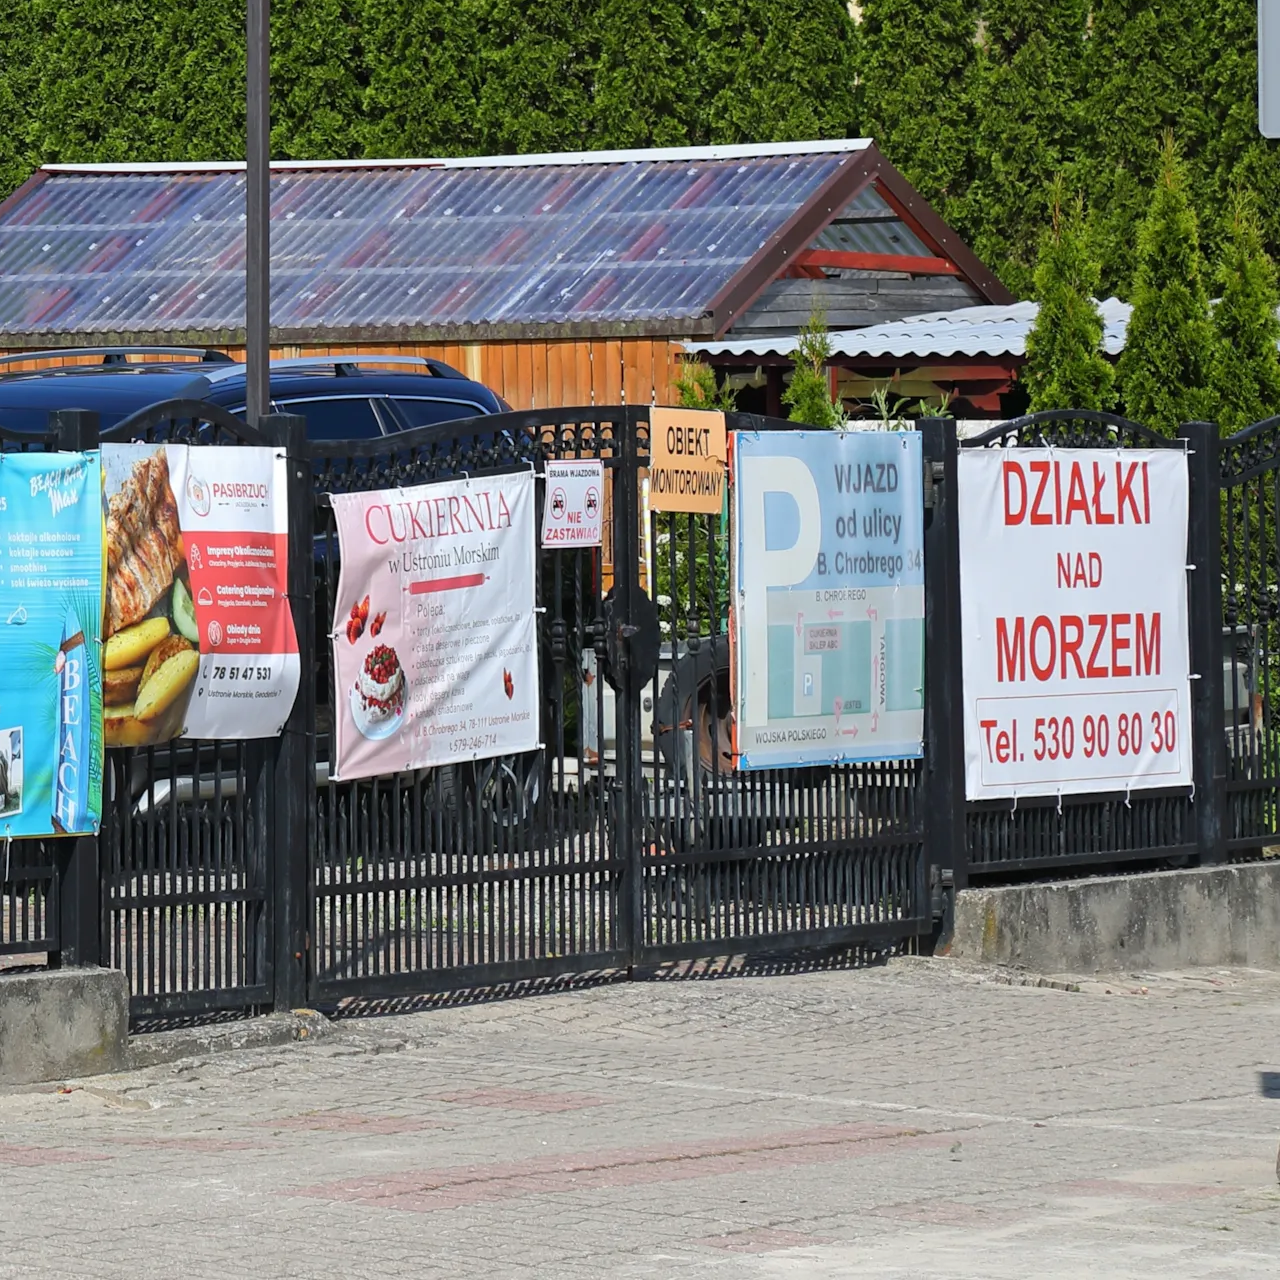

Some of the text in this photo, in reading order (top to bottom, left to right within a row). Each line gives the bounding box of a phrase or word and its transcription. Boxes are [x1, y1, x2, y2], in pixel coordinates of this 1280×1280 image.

[666, 426, 711, 457] OBIEKT
[30, 468, 61, 497] BEACH
[549, 469, 569, 478] BRAMA
[650, 469, 722, 497] MONITOROWANY
[834, 463, 899, 494] WJAZD
[48, 487, 79, 519] Max
[1003, 460, 1151, 526] DZIAŁKI
[365, 490, 512, 545] CUKIERNIA
[567, 512, 582, 524] NIE
[835, 508, 902, 545] od ulicy
[8, 531, 81, 545] koktajle alkoholowe
[545, 524, 598, 541] ZASTAWIAĆ
[9, 547, 74, 560] koktajle owocowe
[388, 542, 500, 574] w Ustroniu Morskim
[817, 549, 922, 579] B. Chrobrego 34
[1057, 552, 1103, 589] NAD
[742, 456, 821, 728] P
[816, 591, 823, 602] B.
[417, 604, 446, 619] Poleca:
[226, 623, 248, 637] Obiady
[464, 634, 490, 647] pieczone
[996, 612, 1161, 683] MORZEM
[445, 653, 473, 665] sztukowe
[213, 666, 271, 680] 78 51 47 531
[446, 672, 455, 680] na
[208, 690, 232, 698] Ustronie
[804, 673, 813, 696] P
[468, 717, 488, 729] 78-111
[488, 714, 510, 727] Ustronie
[510, 710, 531, 723] Morskie
[56, 658, 81, 833] BEACH
[453, 733, 497, 753] 579-246-714
[755, 728, 827, 744] WOJSKA POLSKIEGO
[980, 710, 1176, 764] Tel. 530 90 80 30
